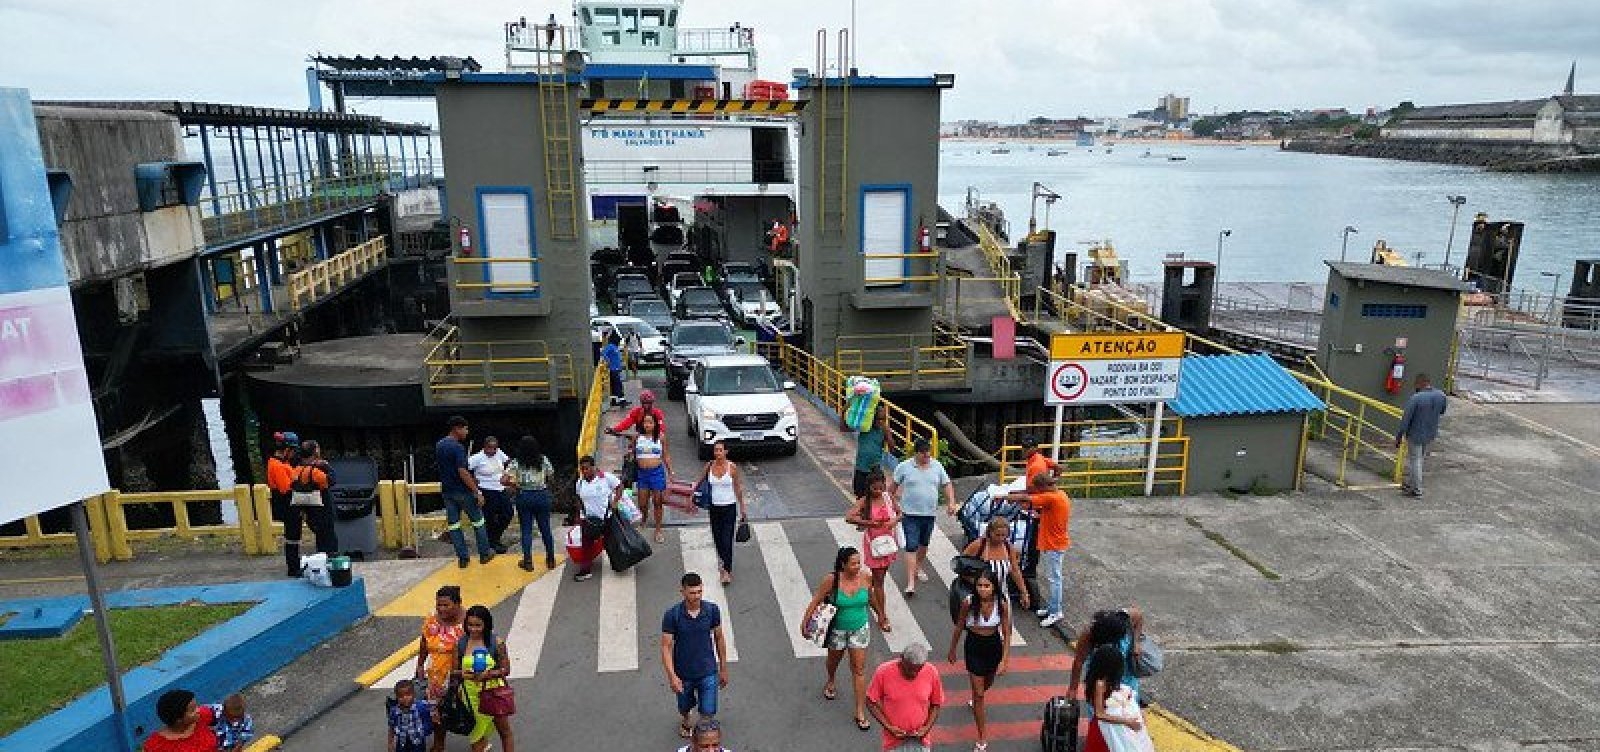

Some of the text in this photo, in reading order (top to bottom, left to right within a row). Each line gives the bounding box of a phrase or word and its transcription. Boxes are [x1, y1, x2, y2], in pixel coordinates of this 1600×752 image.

[613, 130, 644, 138] MARIA
[650, 130, 705, 138] BETHANIA
[1080, 338, 1157, 355] ATENÇÃO
[1107, 363, 1137, 372] RODOVIA
[1124, 375, 1139, 384] BOM
[1141, 374, 1177, 384] DESPACHO
[1103, 388, 1127, 396] PONTE
[1128, 388, 1139, 396] DO
